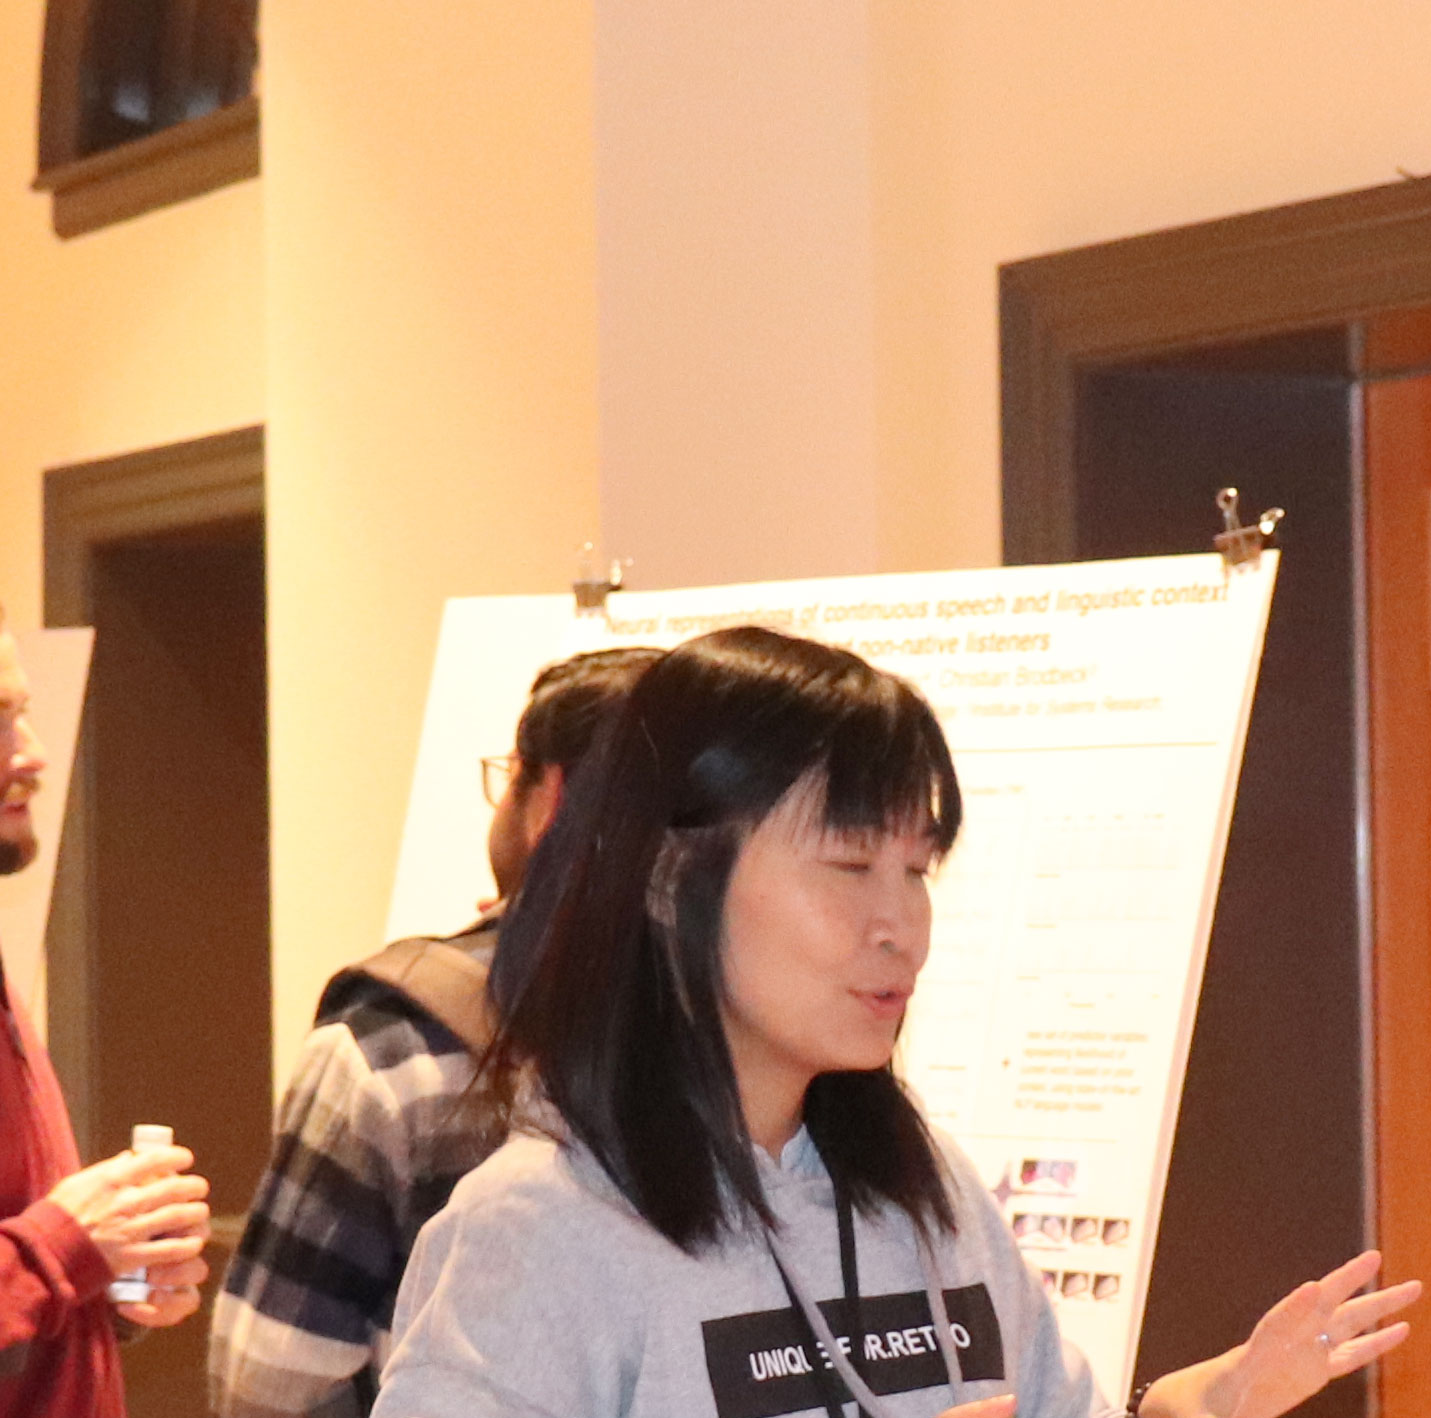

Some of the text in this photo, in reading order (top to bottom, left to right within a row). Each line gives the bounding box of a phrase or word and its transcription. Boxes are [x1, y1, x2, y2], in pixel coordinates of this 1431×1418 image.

[823, 598, 928, 624] continuous
[936, 593, 1006, 621] speech
[1011, 591, 1048, 613] and
[1056, 587, 1145, 616] linguistic
[1152, 584, 1229, 606] context
[967, 630, 1051, 652] listeners
